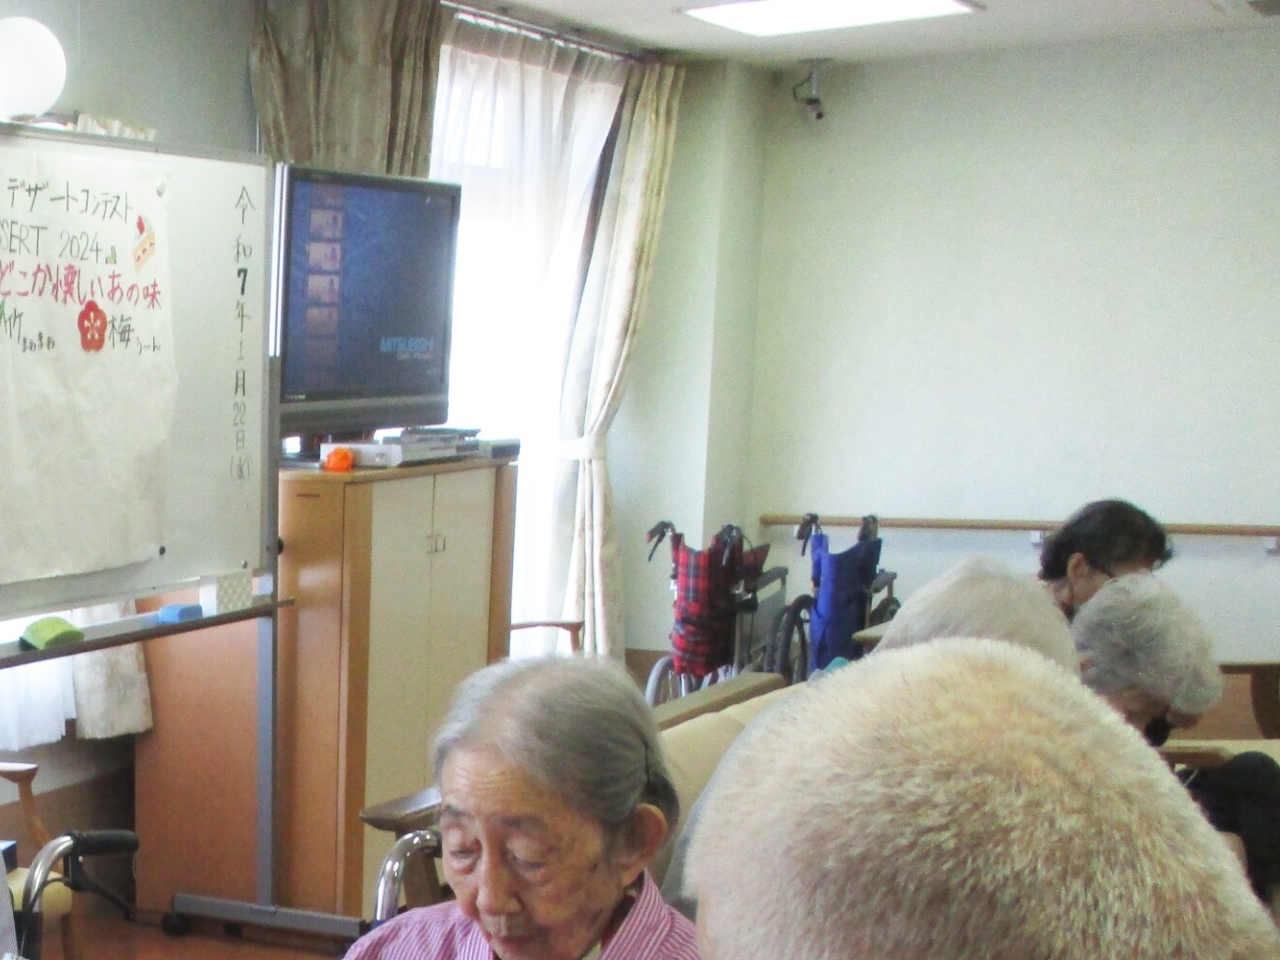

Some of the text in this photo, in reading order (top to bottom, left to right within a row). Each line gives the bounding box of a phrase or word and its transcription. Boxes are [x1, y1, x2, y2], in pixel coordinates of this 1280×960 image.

[7, 178, 133, 224] デザートコンテスト
